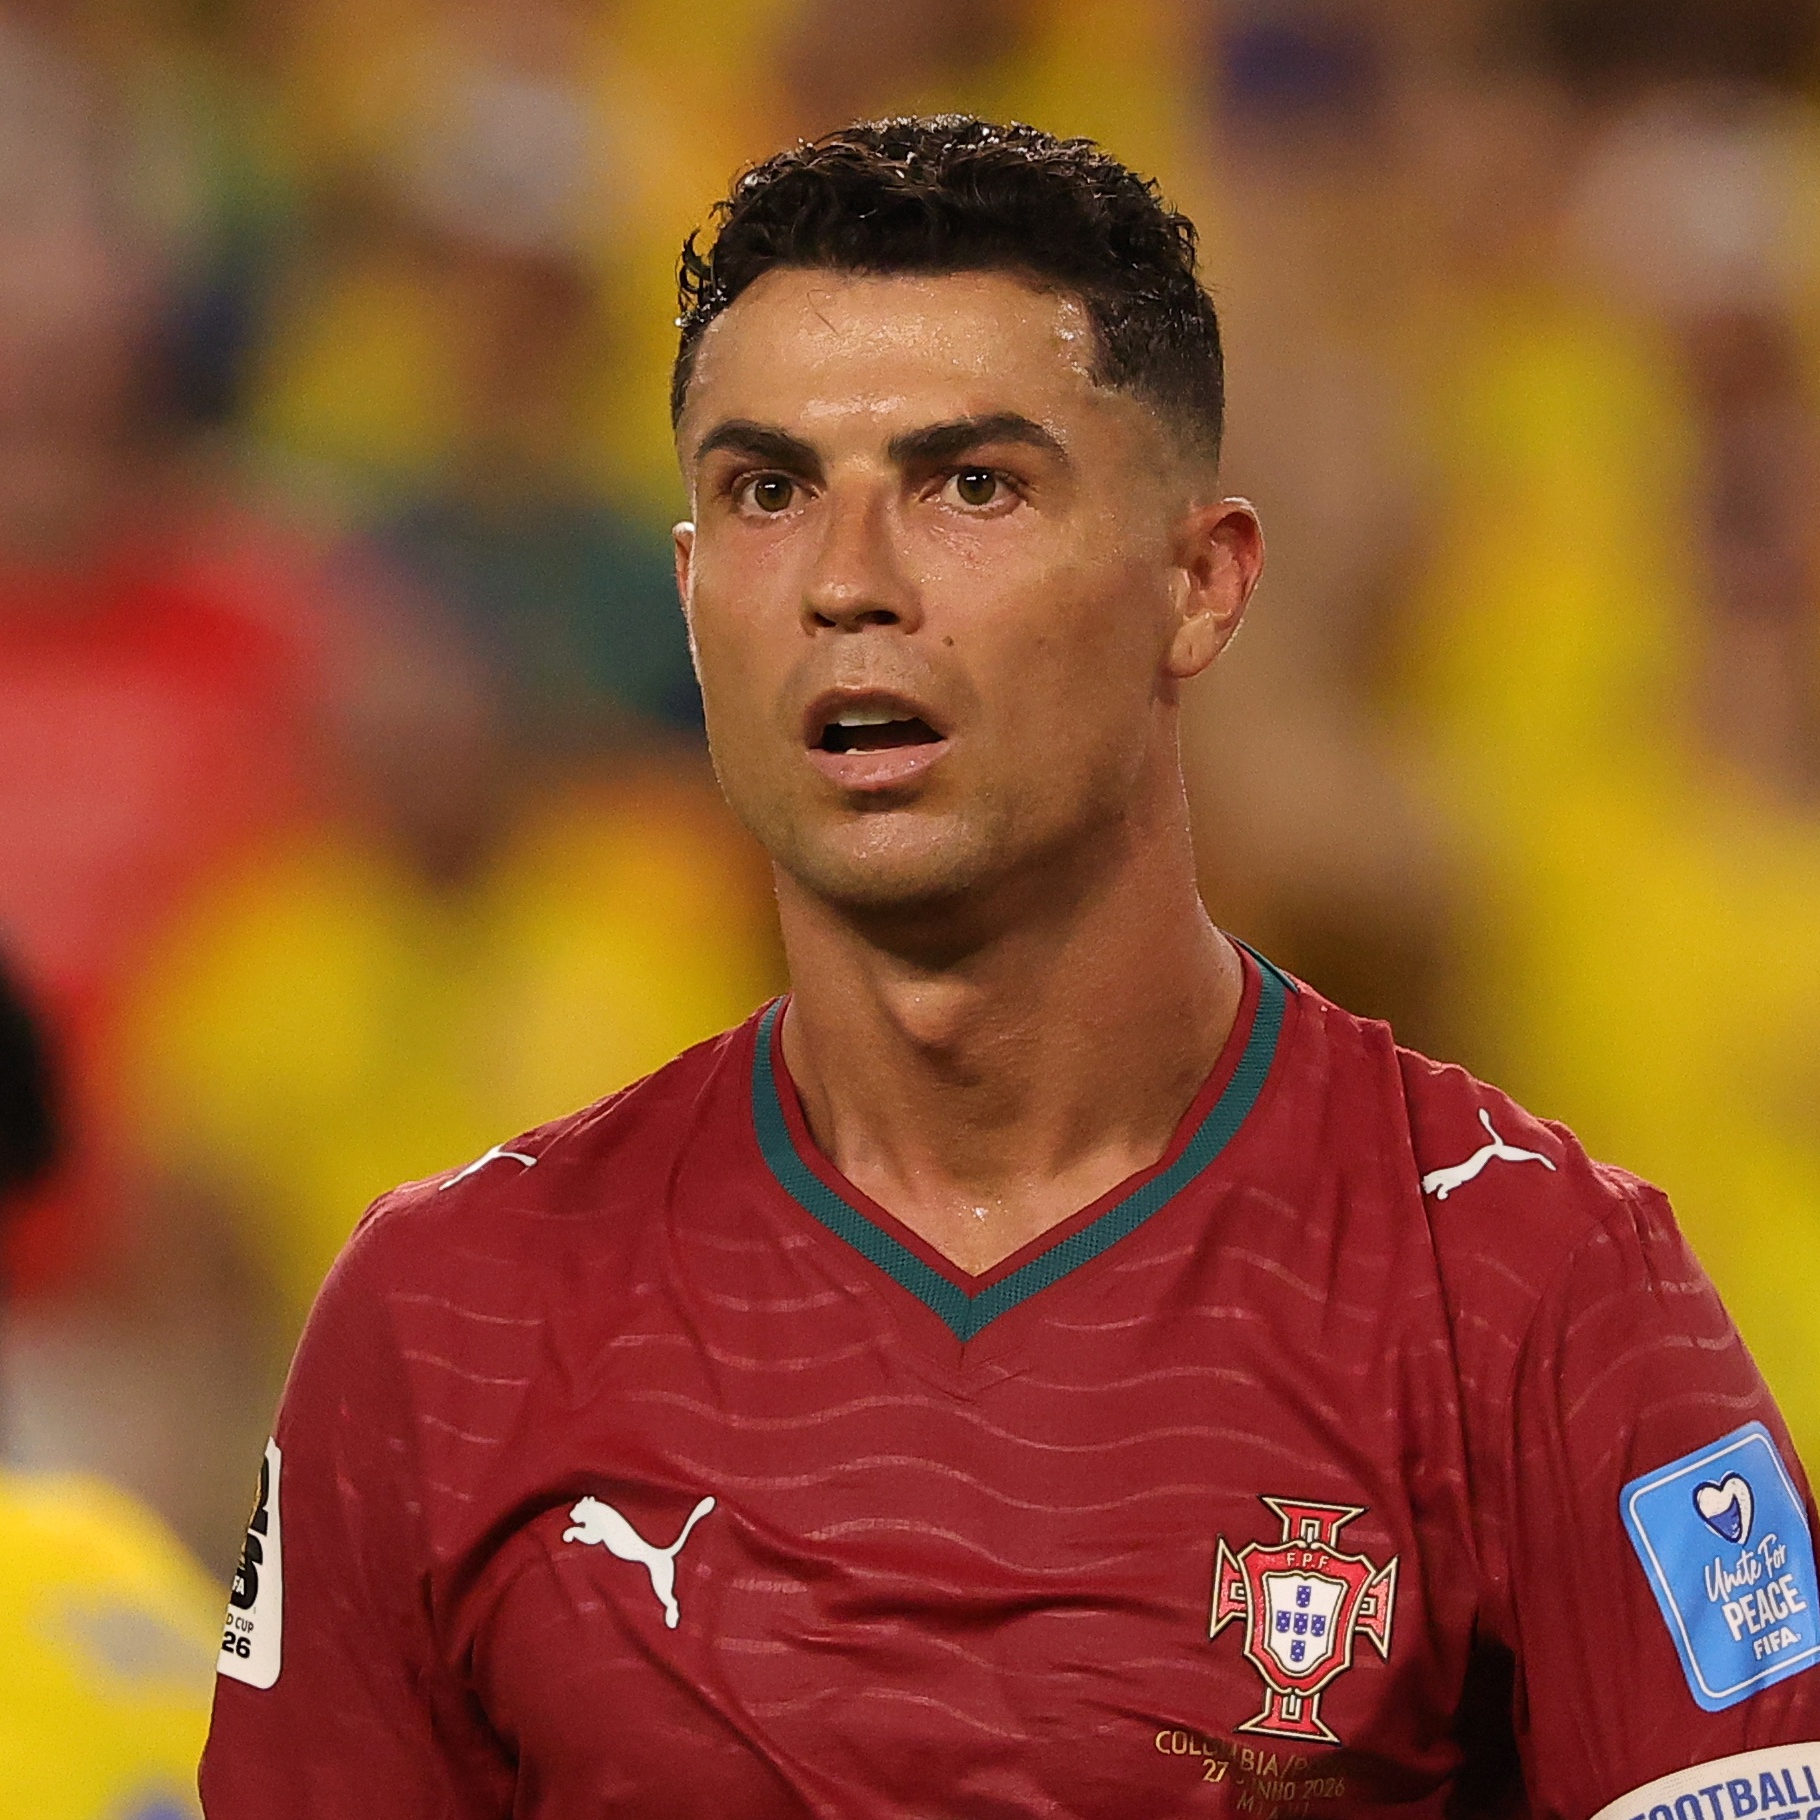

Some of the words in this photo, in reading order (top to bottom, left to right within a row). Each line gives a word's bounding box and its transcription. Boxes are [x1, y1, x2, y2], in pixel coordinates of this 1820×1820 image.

[1705, 1550, 1764, 1603] Unite
[1758, 1533, 1787, 1568] For
[235, 1616, 254, 1634] CUP
[1722, 1573, 1807, 1642] PEACE
[221, 1631, 252, 1659] 26
[1752, 1626, 1798, 1660] FIFA
[1201, 1758, 1230, 1783] 27
[1301, 1777, 1346, 1800] 2026
